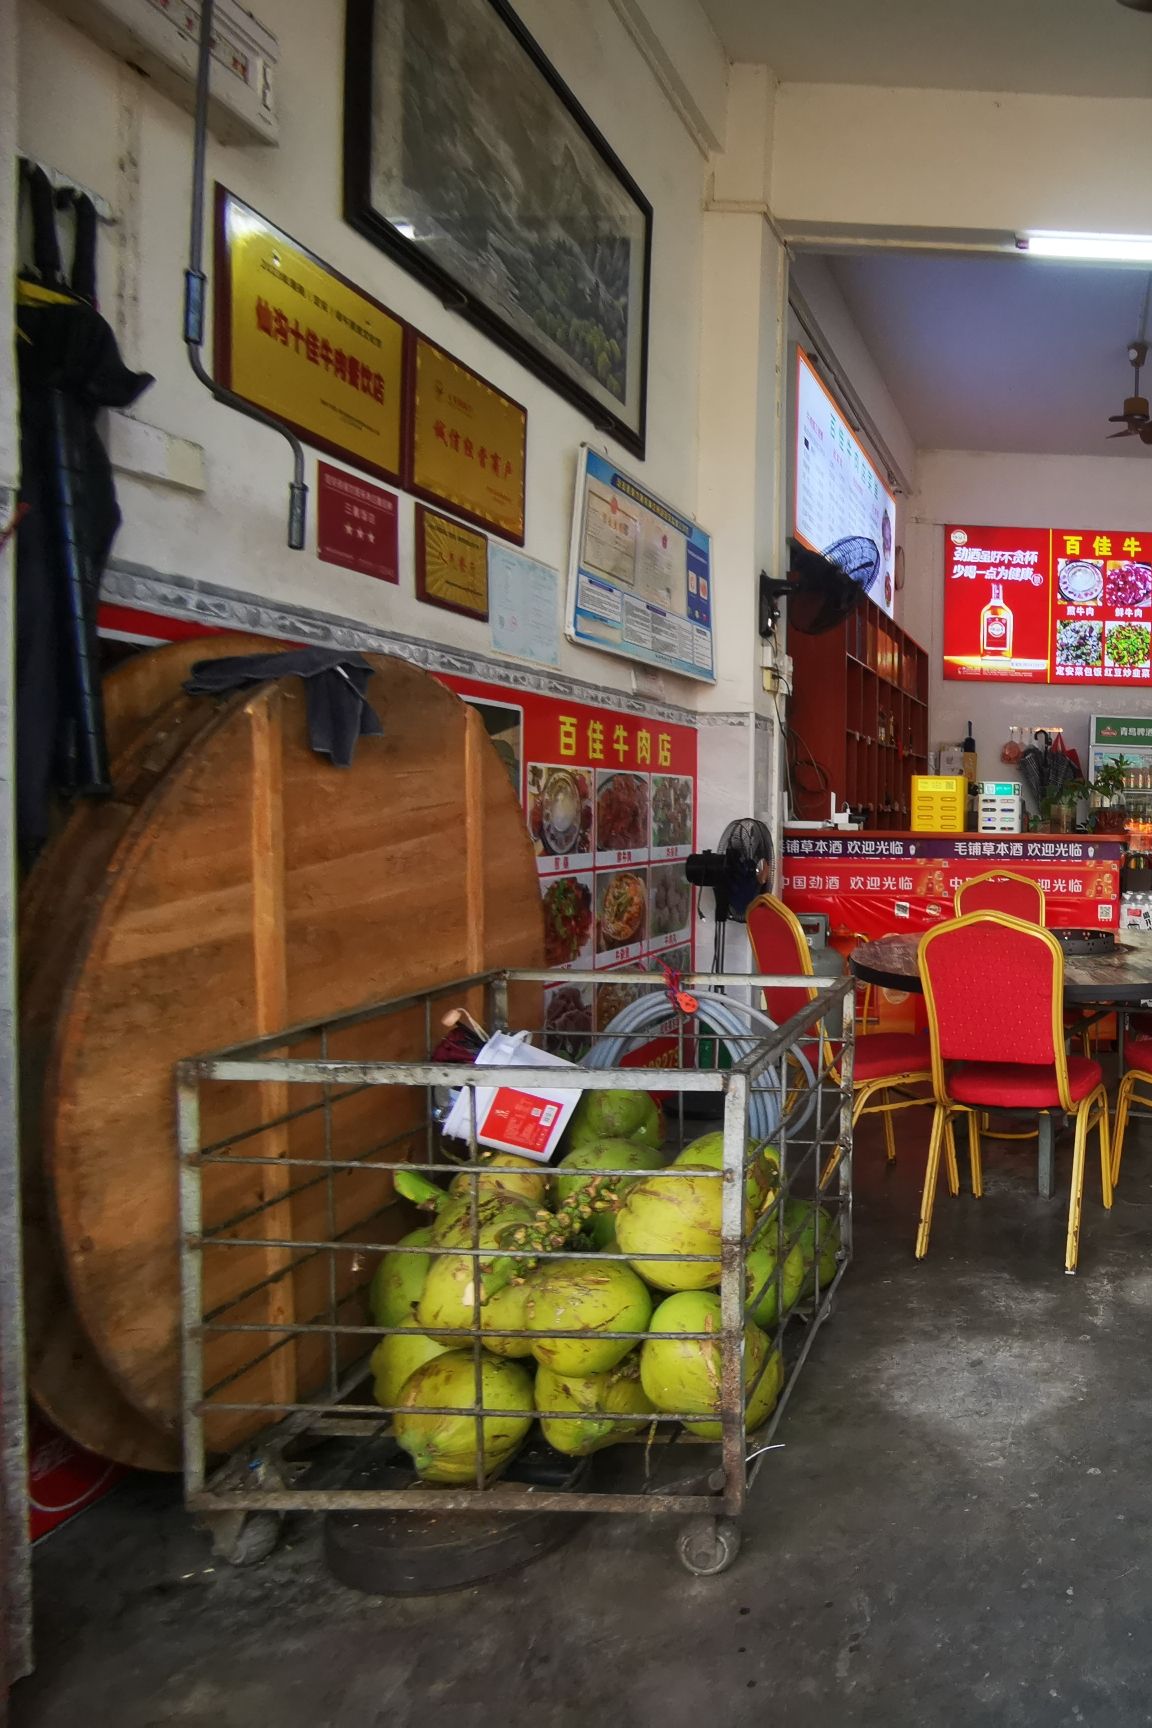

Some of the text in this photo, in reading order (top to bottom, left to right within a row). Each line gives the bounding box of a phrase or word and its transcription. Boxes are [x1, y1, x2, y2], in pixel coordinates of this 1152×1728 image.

[953, 546, 1038, 565] 劲酒虽好不贪杯
[951, 564, 1034, 581] 少喝一点为健康
[558, 715, 672, 767] 百佳牛肉店
[847, 840, 904, 855] 欢迎光临
[953, 841, 1083, 857] 毛铺草本酒 欢迎光临
[849, 876, 913, 890] 欢迎光临
[1037, 878, 1083, 893] 迎光临
